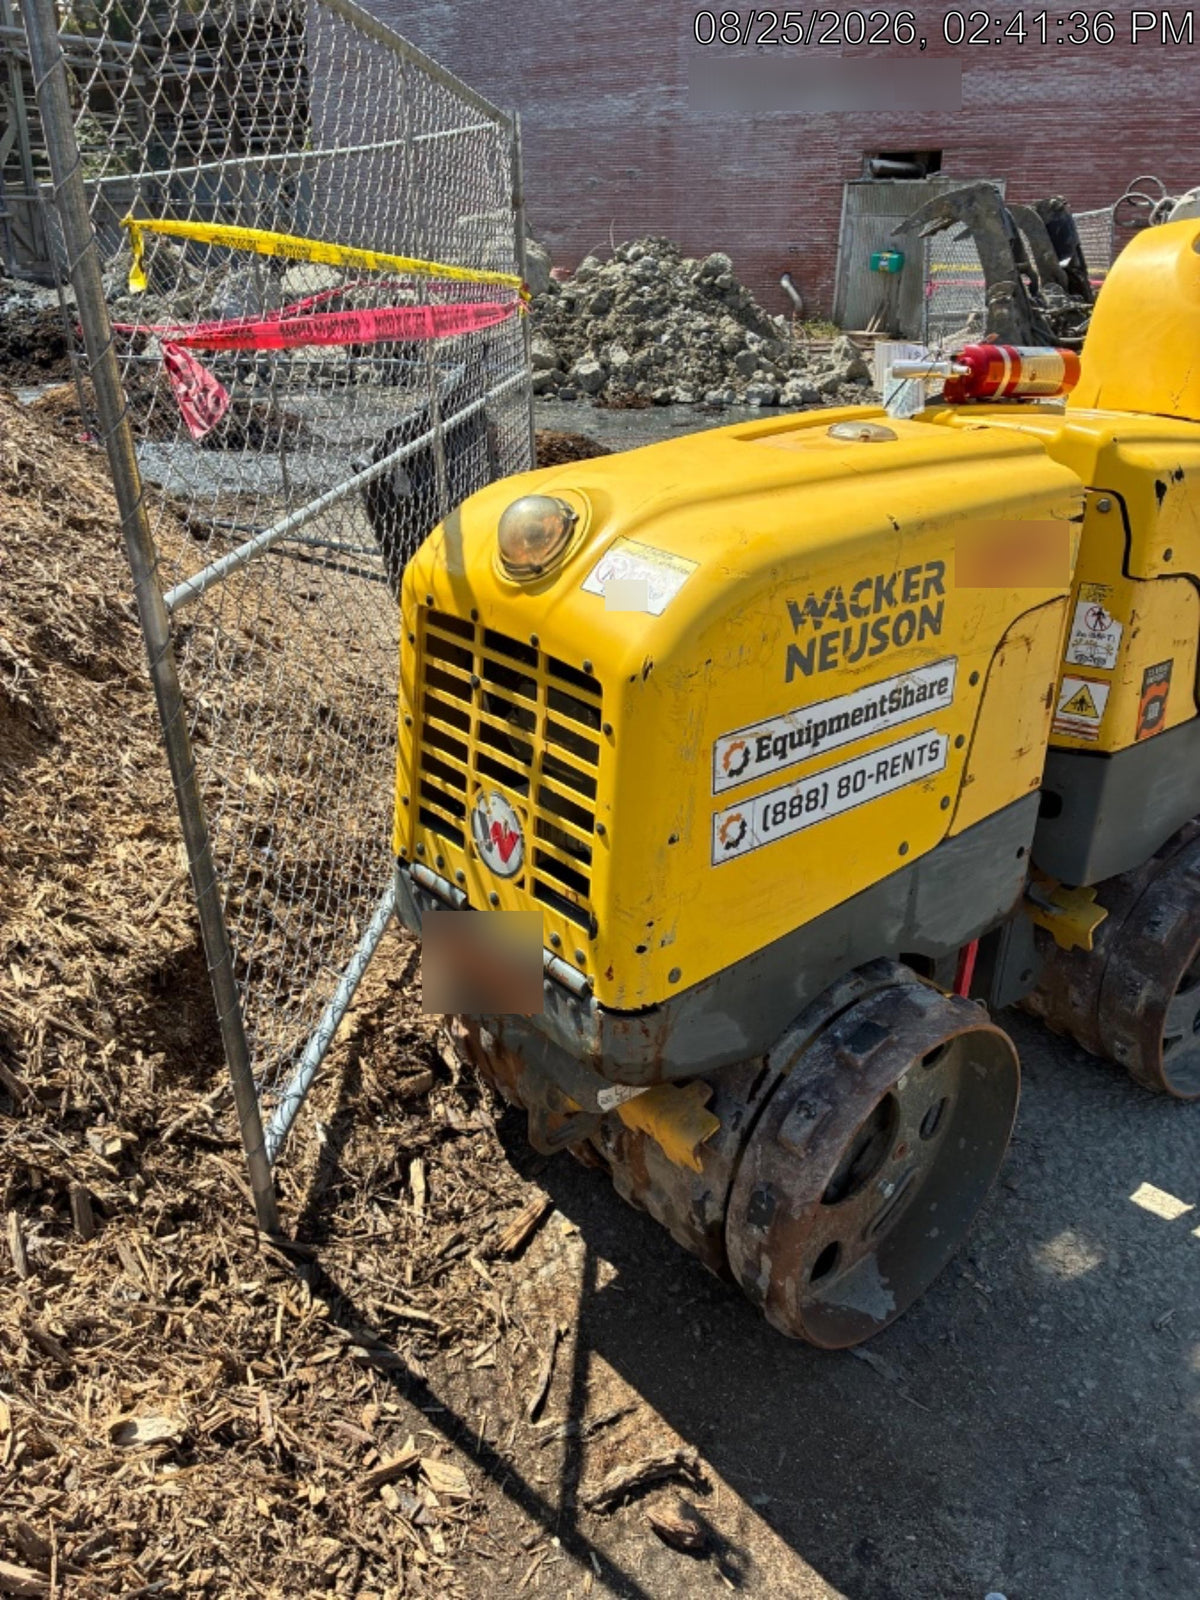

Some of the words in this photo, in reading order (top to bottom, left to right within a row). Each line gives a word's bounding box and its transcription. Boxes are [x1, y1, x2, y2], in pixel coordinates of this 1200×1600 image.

[786, 560, 946, 635] WACKER
[785, 600, 945, 683] NEUSON
[755, 676, 949, 763] EquipmentShare
[762, 782, 829, 832] (888)
[836, 739, 941, 799] 80-RENTS
